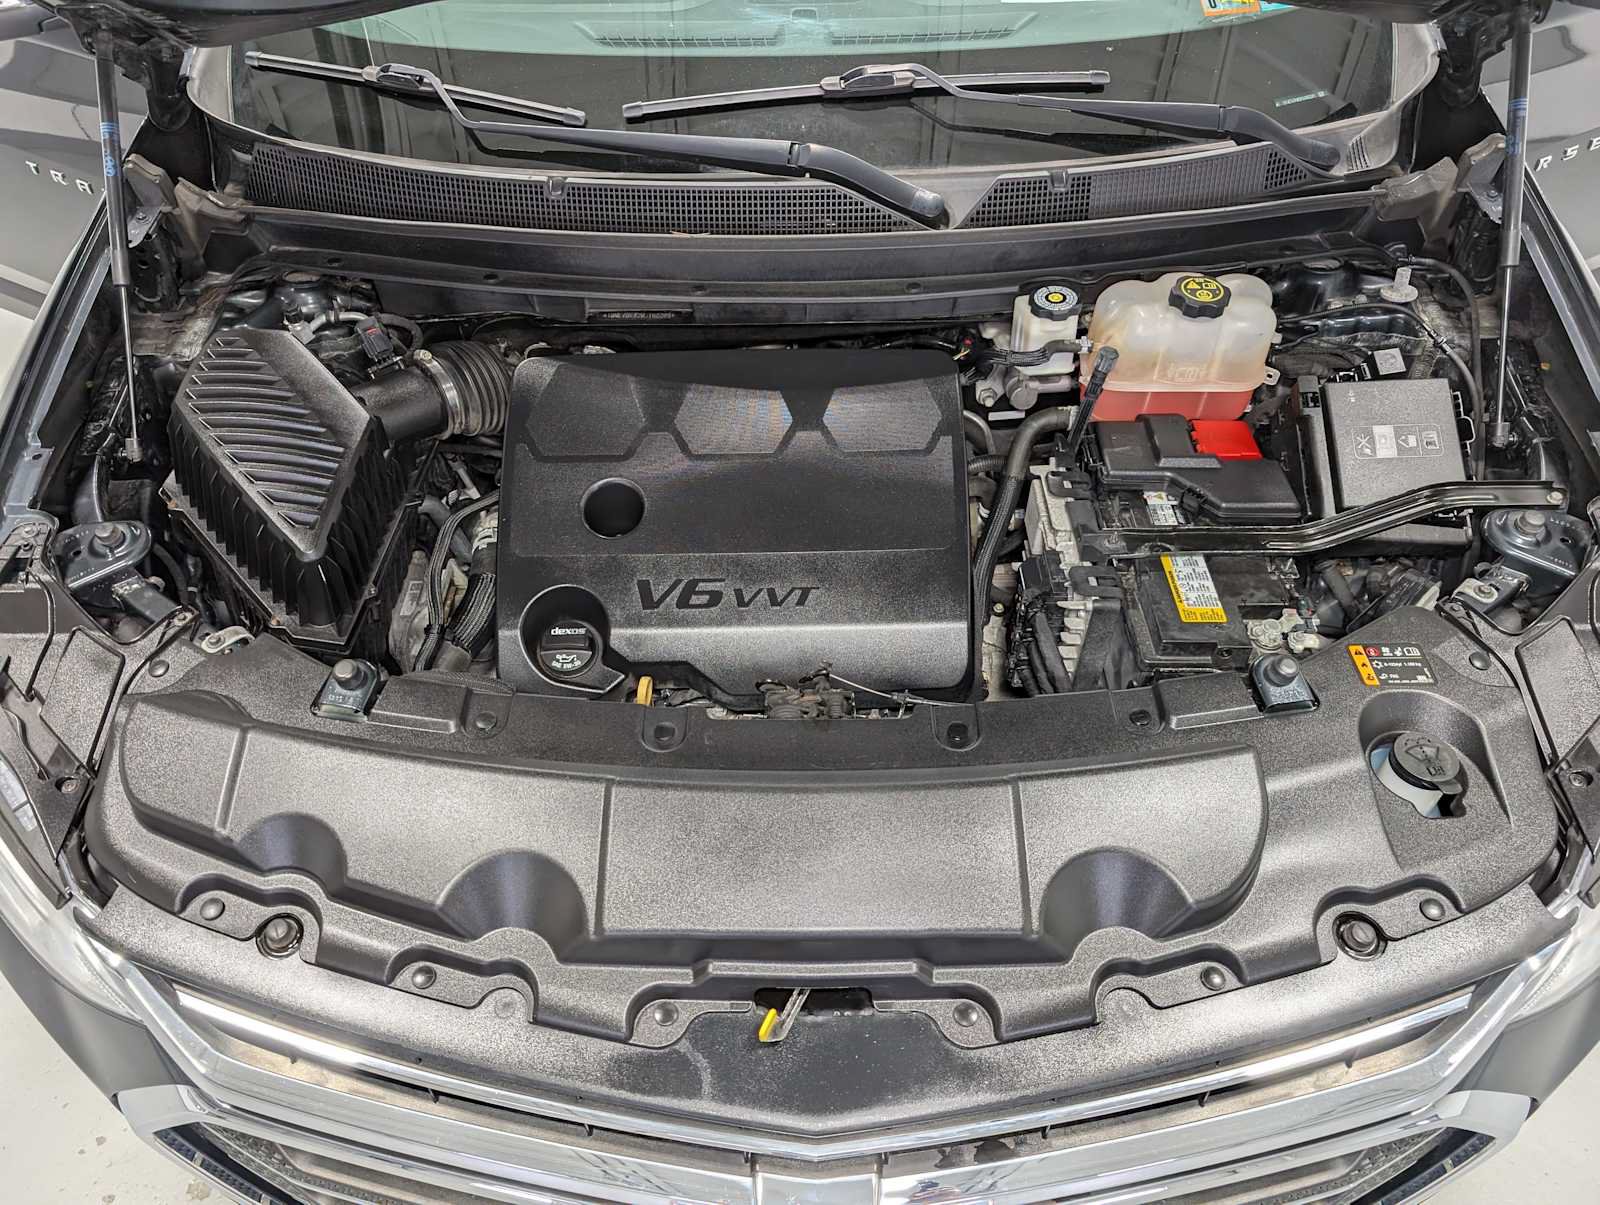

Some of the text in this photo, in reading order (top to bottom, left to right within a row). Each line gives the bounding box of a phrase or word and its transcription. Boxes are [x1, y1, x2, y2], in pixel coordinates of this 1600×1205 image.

[25, 160, 104, 195] TRA
[636, 577, 820, 610] V6 VVT
[550, 626, 587, 636] dexos
